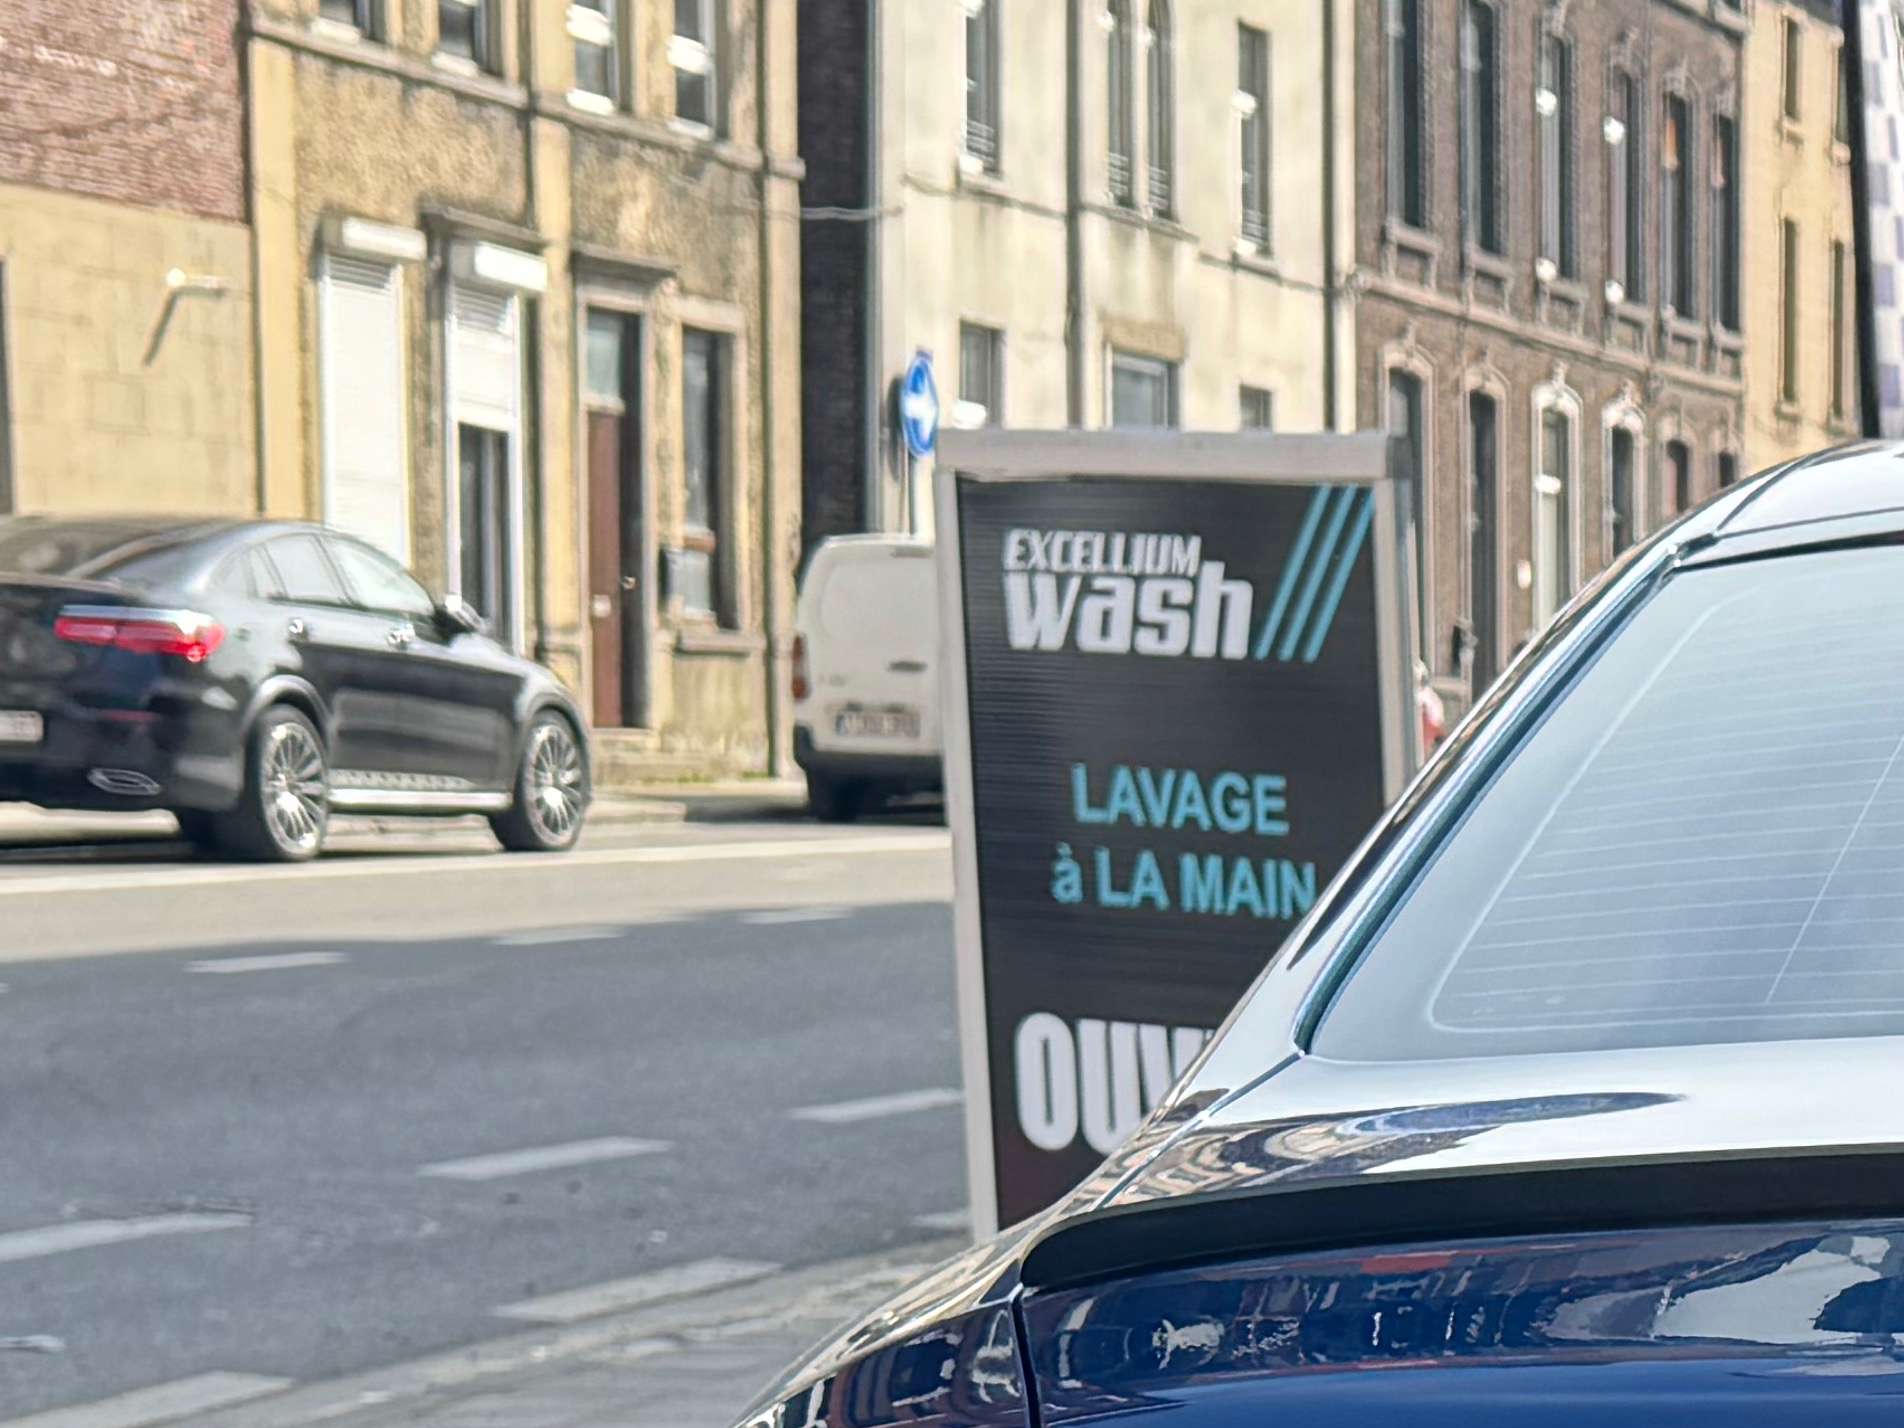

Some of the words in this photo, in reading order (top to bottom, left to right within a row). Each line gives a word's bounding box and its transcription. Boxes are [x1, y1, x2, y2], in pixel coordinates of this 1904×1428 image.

[1003, 529, 1202, 577] EXCELLIUM
[1003, 561, 1254, 661] wash
[1071, 762, 1290, 836] LAVAGE
[1051, 841, 1083, 904] à
[1095, 845, 1170, 911] LA
[1179, 852, 1316, 920] MAIN
[1015, 1011, 1218, 1156] OUV
